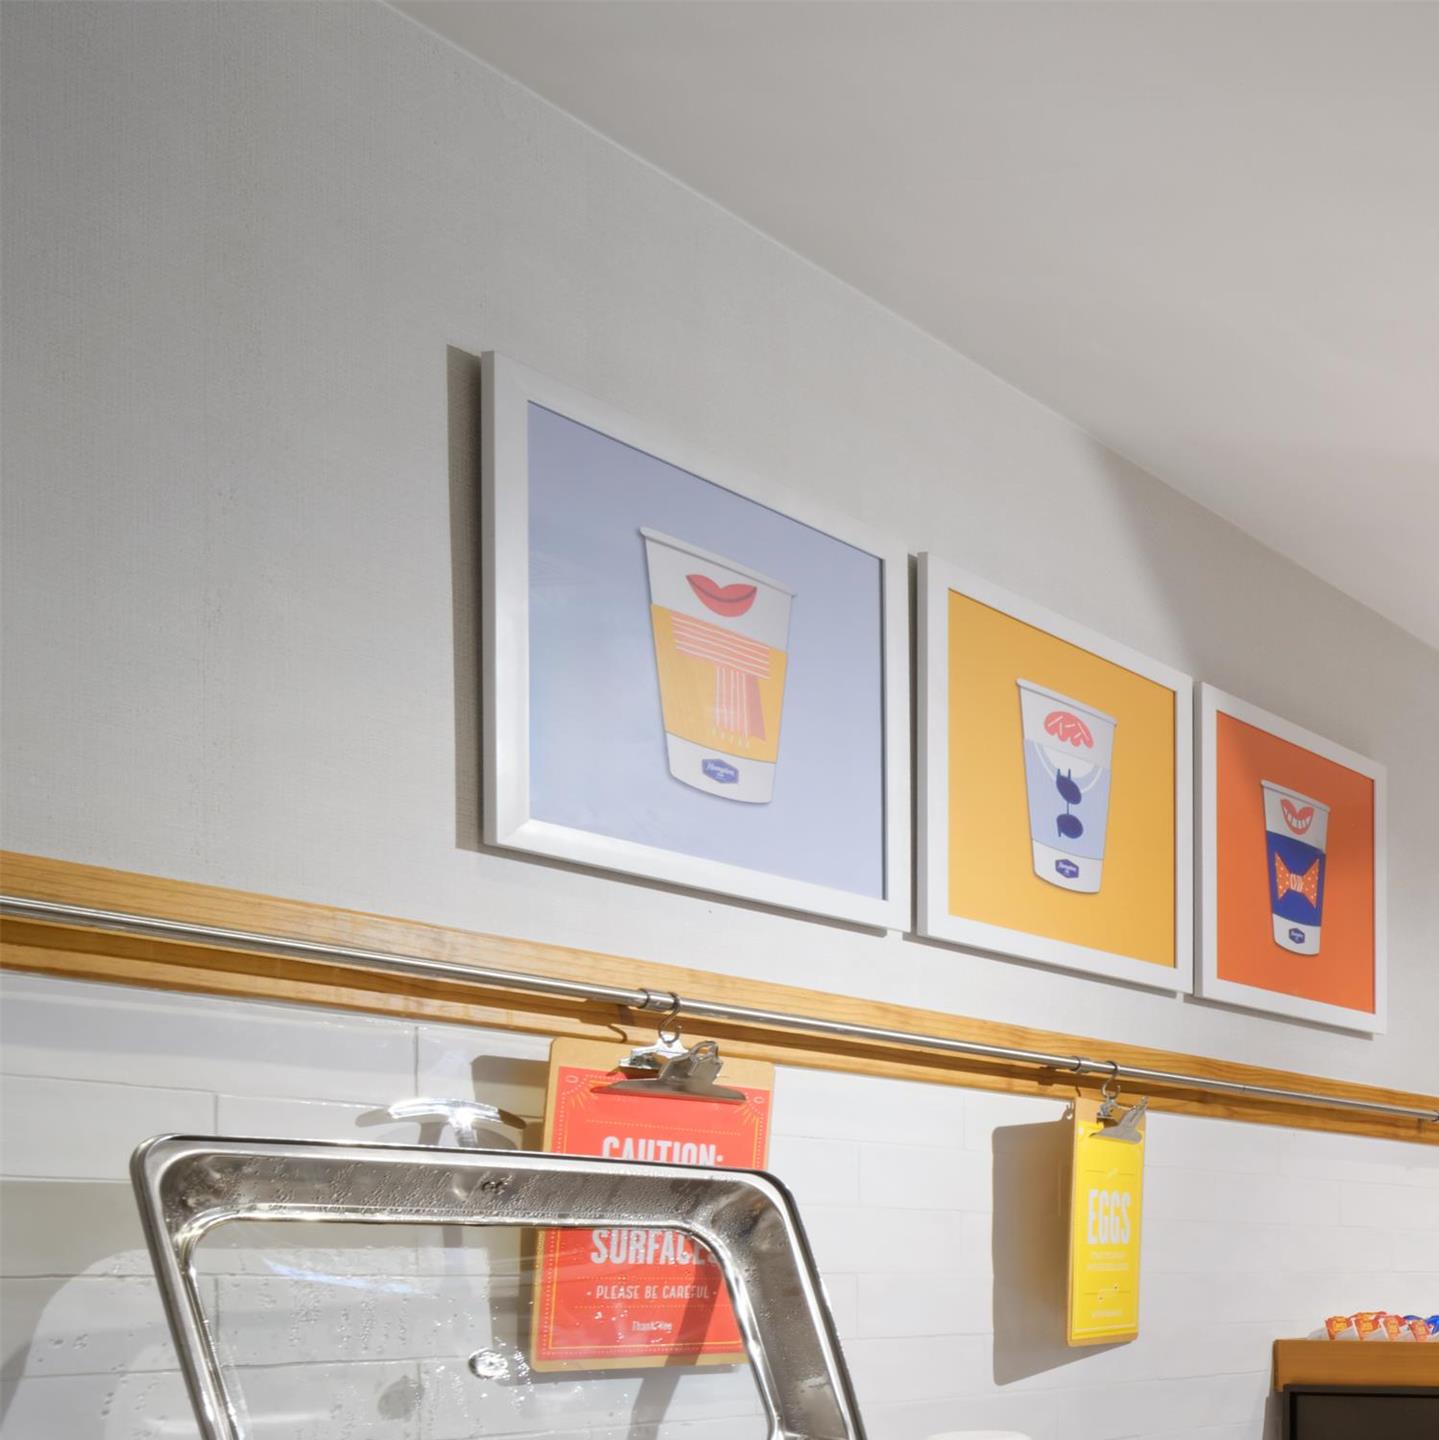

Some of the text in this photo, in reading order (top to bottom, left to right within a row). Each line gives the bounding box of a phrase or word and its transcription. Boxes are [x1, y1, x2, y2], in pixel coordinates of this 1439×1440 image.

[1086, 1188, 1131, 1245] EGGS
[590, 1228, 719, 1266] SURFAC
[595, 1284, 710, 1300] PLEASE BE CAREFUL
